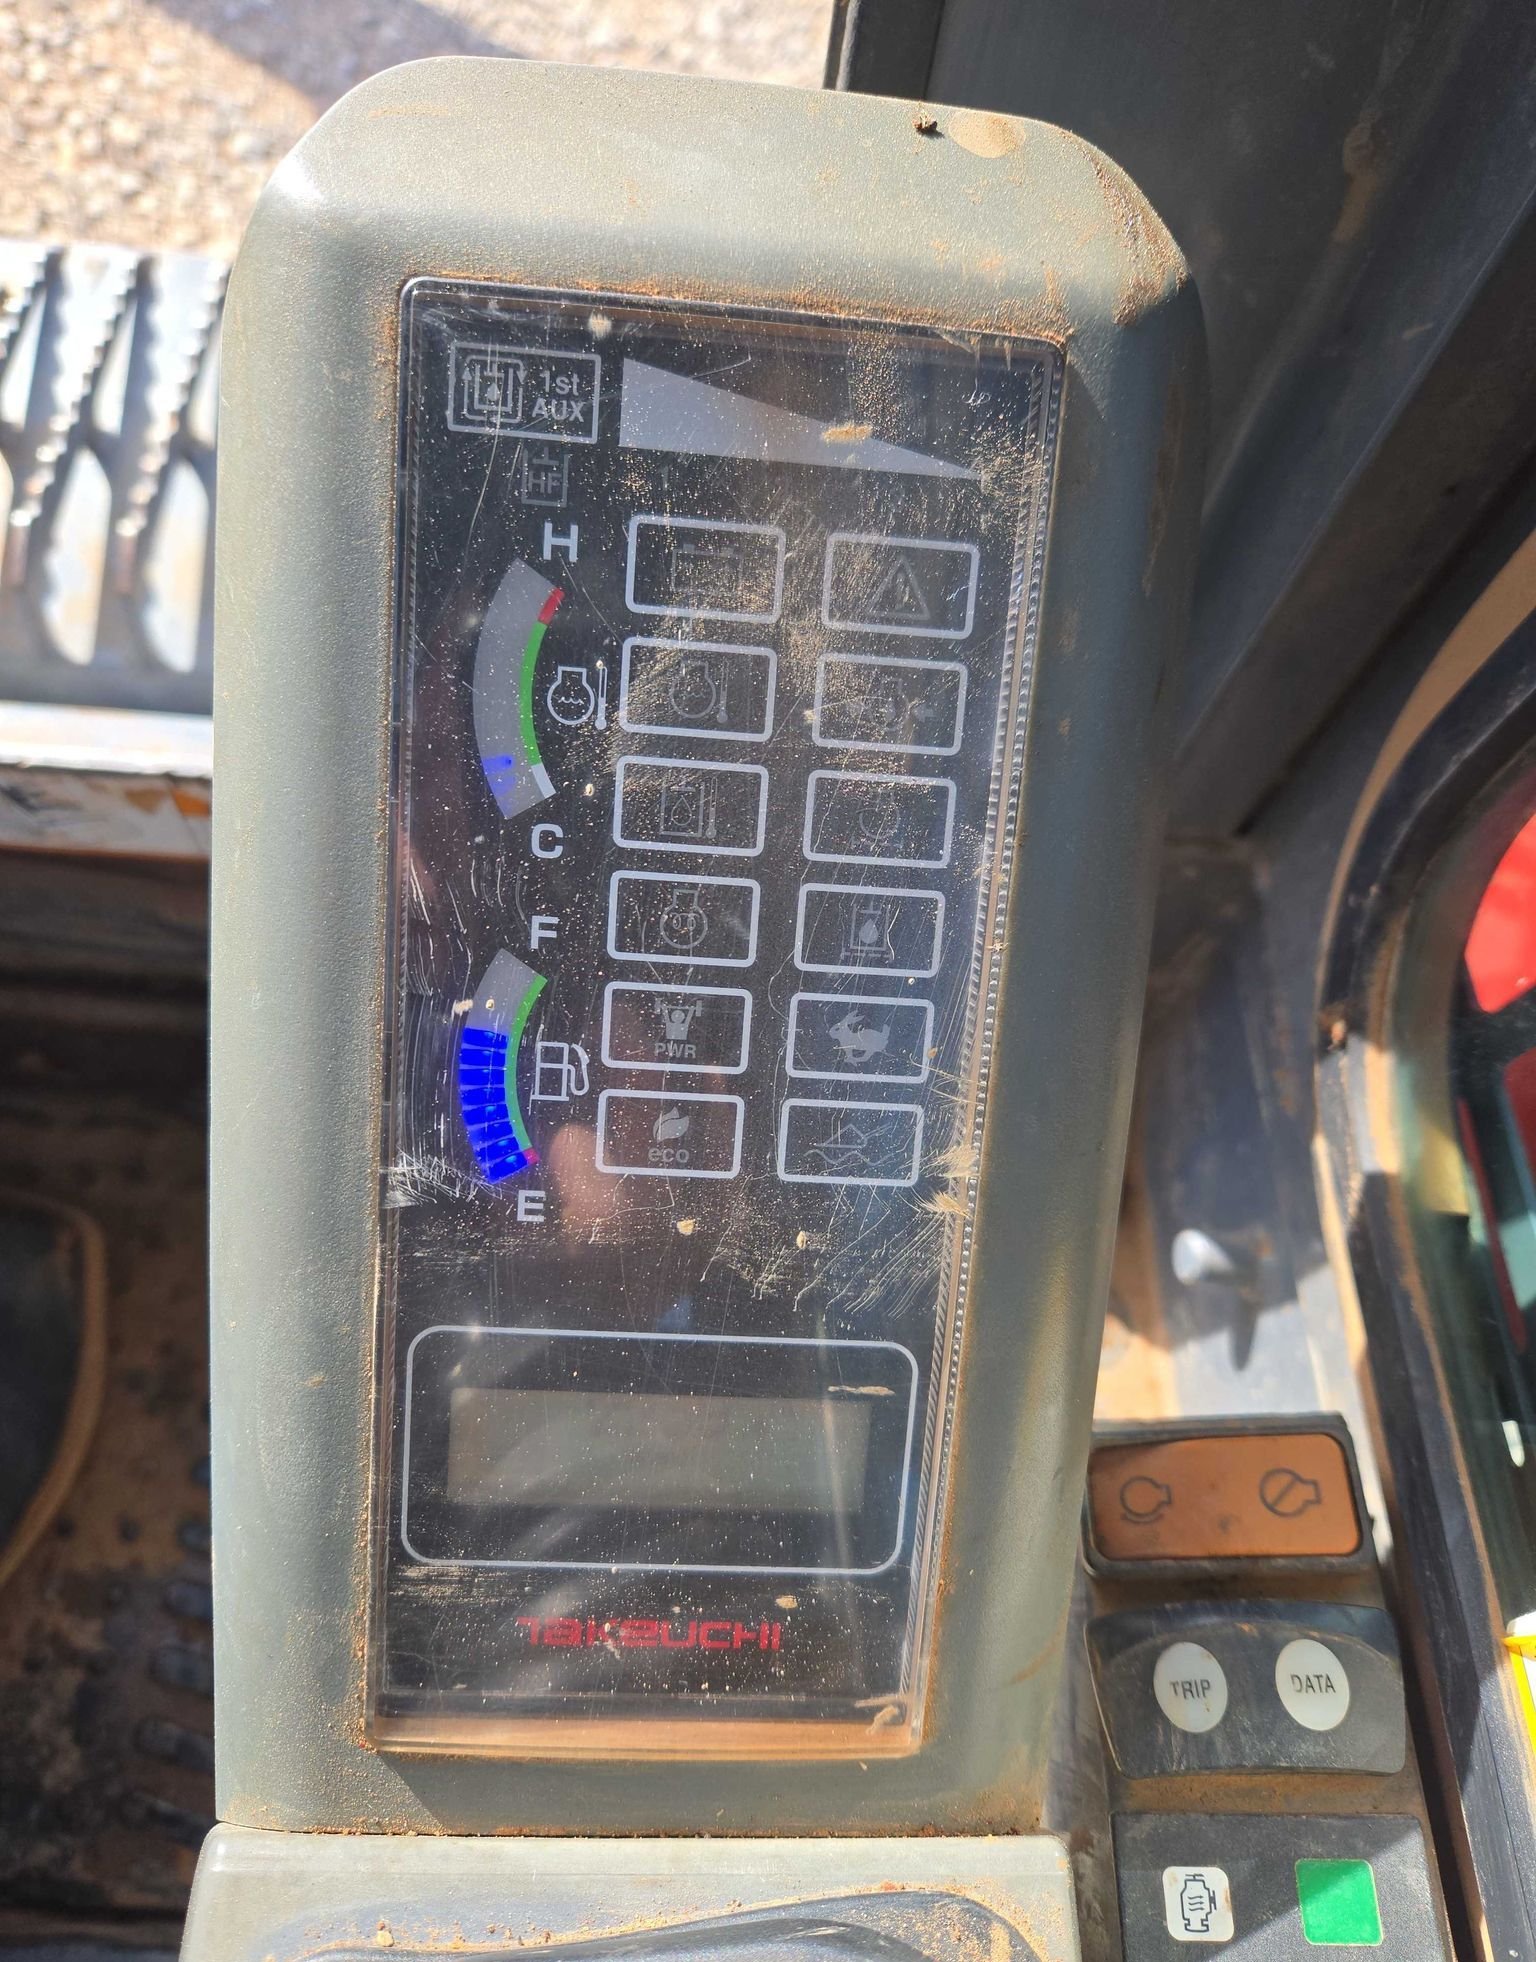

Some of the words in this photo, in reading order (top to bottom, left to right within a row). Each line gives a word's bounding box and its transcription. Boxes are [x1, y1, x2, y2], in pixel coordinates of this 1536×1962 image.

[537, 372, 580, 397] 1st
[531, 399, 585, 423] AUX
[528, 471, 563, 494] HF
[543, 520, 579, 562] H
[531, 823, 564, 858] C
[531, 916, 559, 949] F
[654, 1042, 697, 1060] PWR
[648, 1146, 690, 1164] eco
[517, 1190, 546, 1222] E
[1170, 1679, 1211, 1699] TRIP
[1291, 1674, 1337, 1694] DATA
